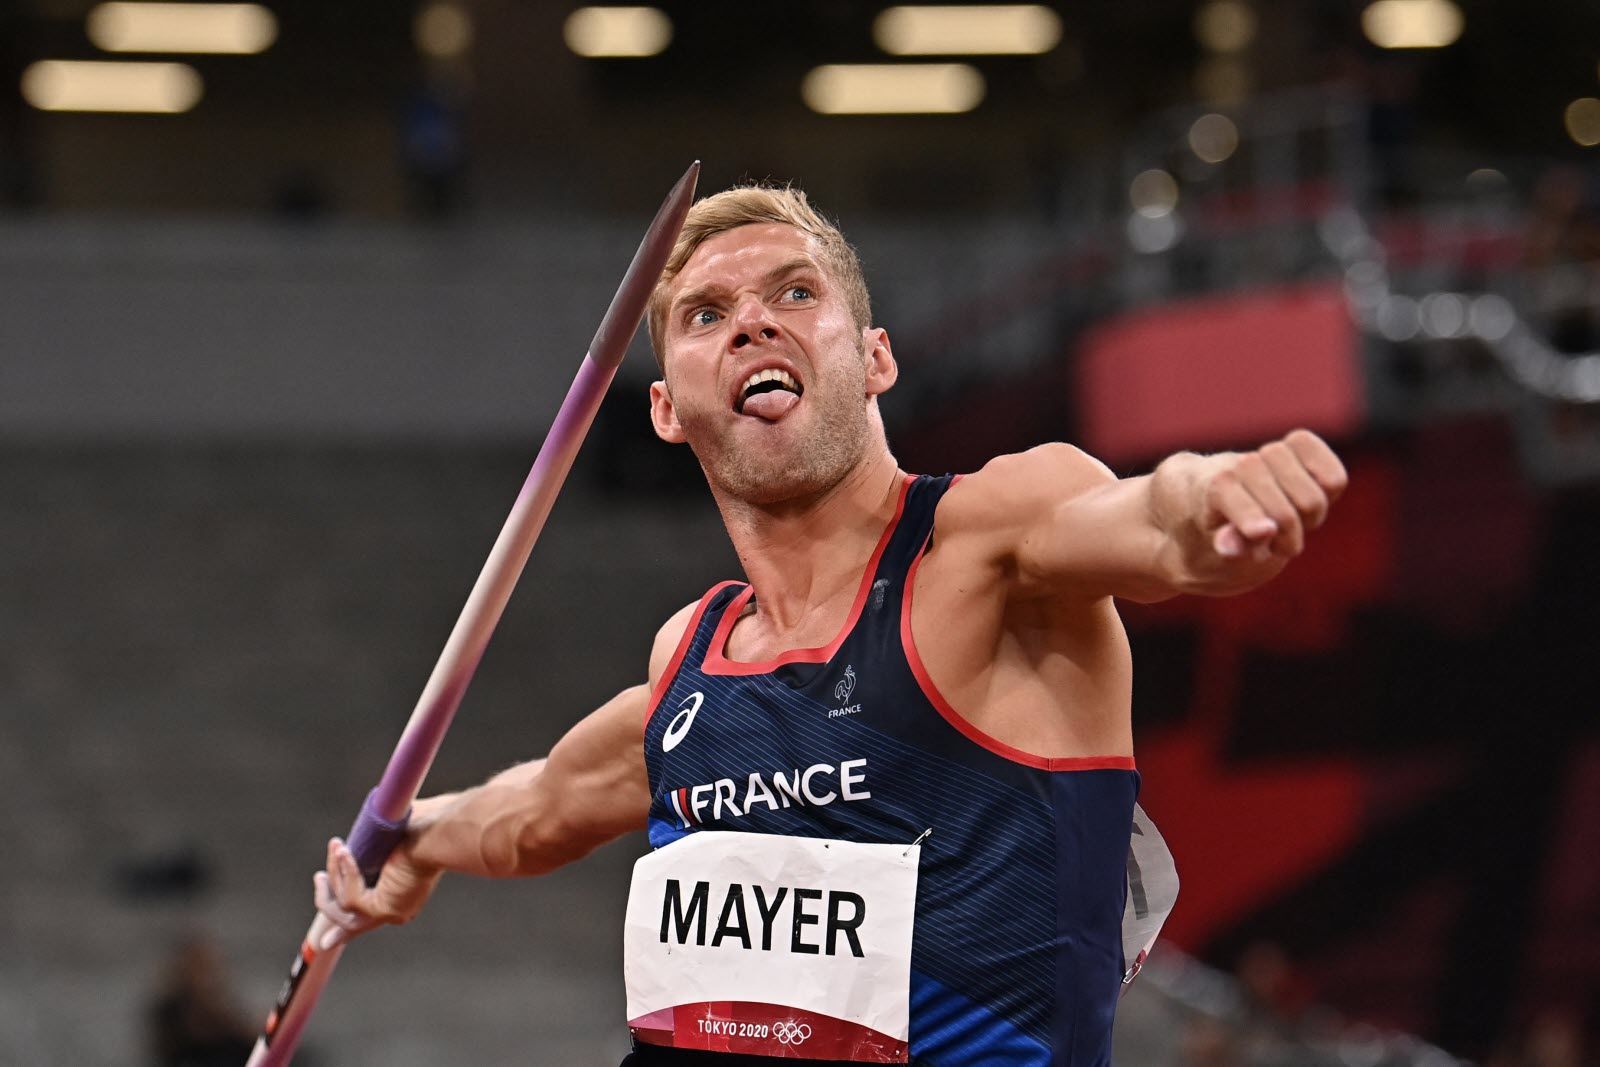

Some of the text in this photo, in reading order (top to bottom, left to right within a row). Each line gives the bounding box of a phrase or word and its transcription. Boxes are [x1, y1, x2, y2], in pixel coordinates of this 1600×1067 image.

[828, 703, 862, 719] FRANCE
[690, 758, 871, 823] FRANCE
[659, 878, 866, 958] MAYER
[697, 1019, 769, 1038] TOKYO 2020
